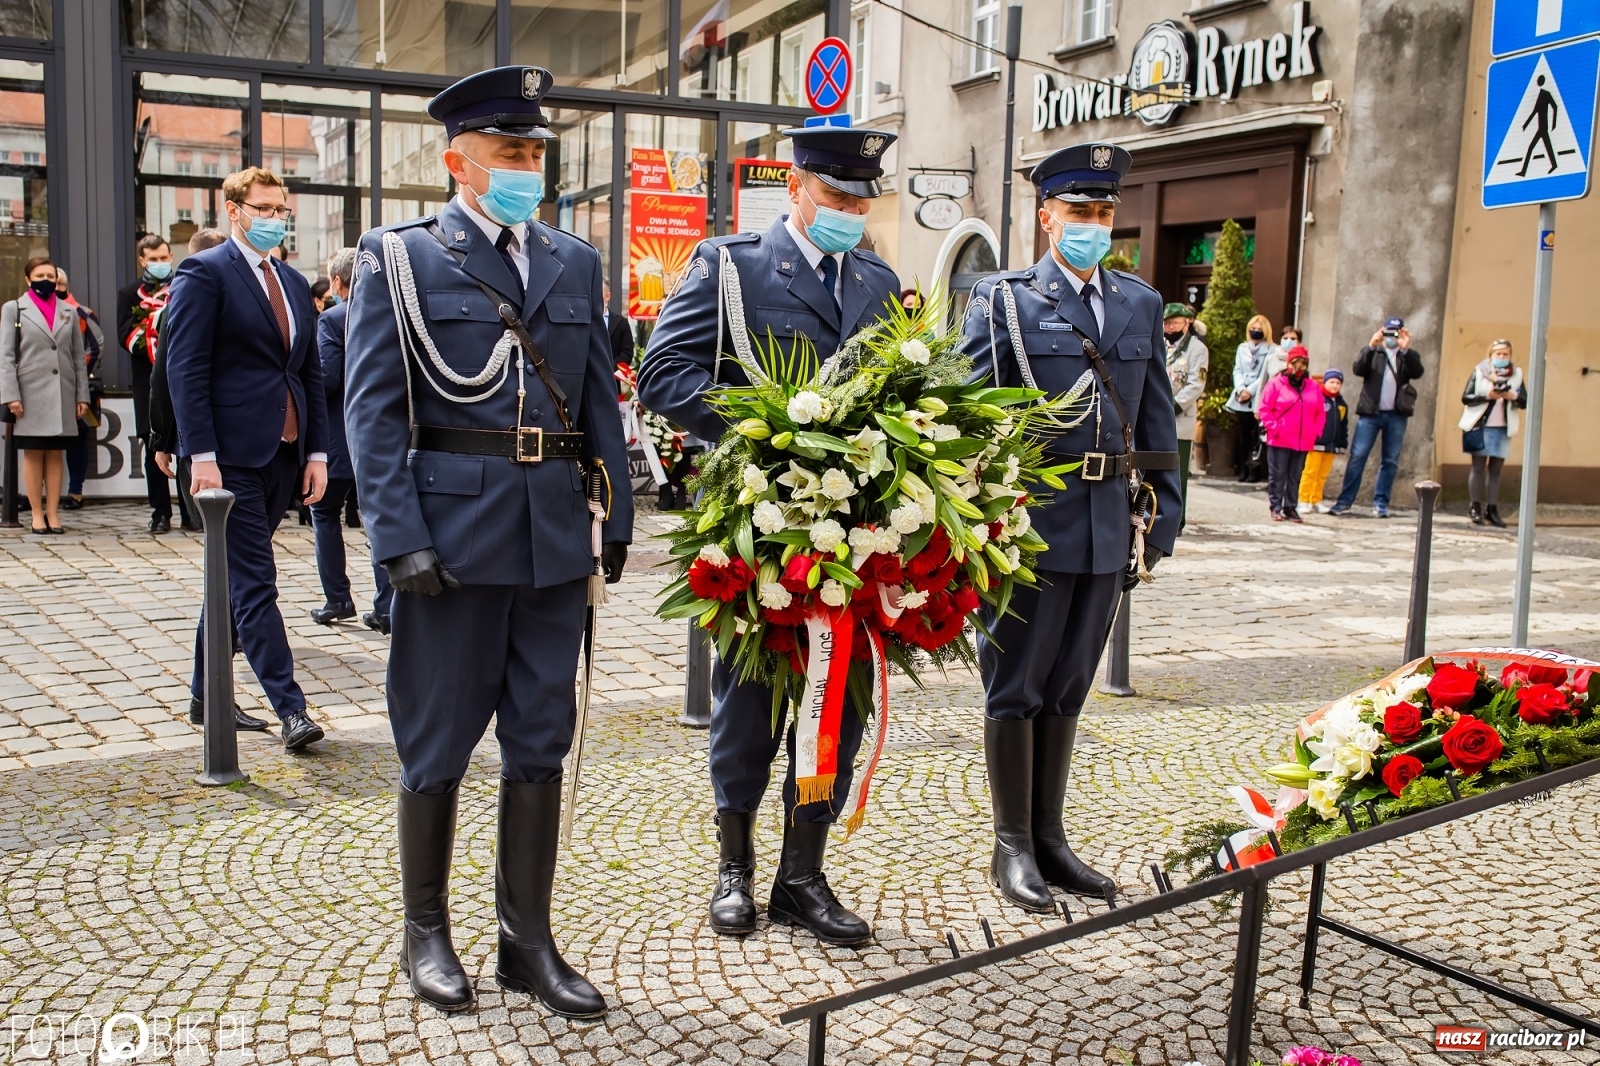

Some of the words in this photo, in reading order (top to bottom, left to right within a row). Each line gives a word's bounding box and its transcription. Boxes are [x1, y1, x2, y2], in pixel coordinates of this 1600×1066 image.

[1031, 72, 1128, 133] Browar
[1195, 1, 1317, 105] Rynek
[632, 150, 648, 160] Pizza
[649, 151, 665, 161] Time
[632, 162, 652, 175] Druga
[652, 164, 667, 175] pizza
[641, 174, 663, 187] gratis!
[926, 178, 958, 192] BUTIK
[641, 195, 698, 217] Promocja
[649, 217, 668, 226] DWA
[668, 218, 688, 227] PIWA
[635, 225, 644, 233] W
[644, 225, 666, 235] CENIE
[667, 227, 701, 237] JEDNEGO
